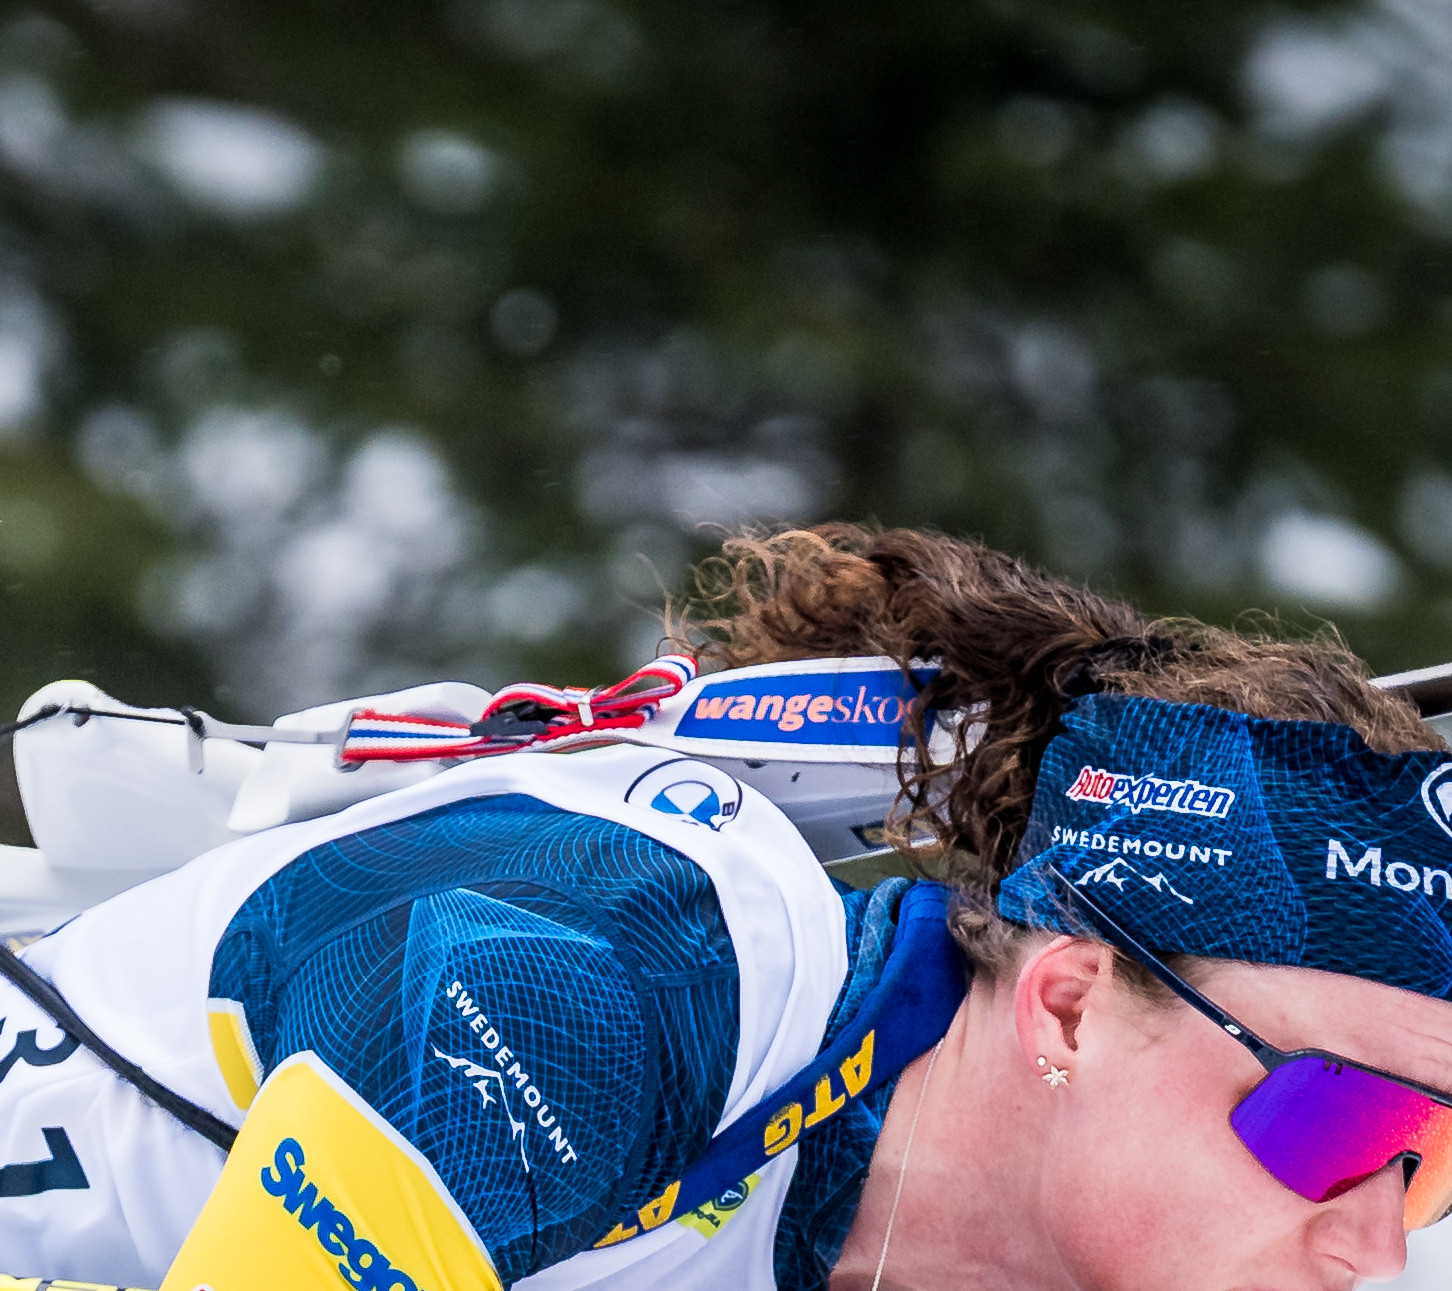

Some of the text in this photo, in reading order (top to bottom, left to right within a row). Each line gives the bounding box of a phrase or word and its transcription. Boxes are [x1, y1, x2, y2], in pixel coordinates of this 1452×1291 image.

[694, 684, 918, 732] wangesko
[1070, 768, 1231, 813] Autoexperten
[1051, 826, 1233, 866] SWEDEMOUNT
[446, 980, 578, 1164] SWEDEMOUNT
